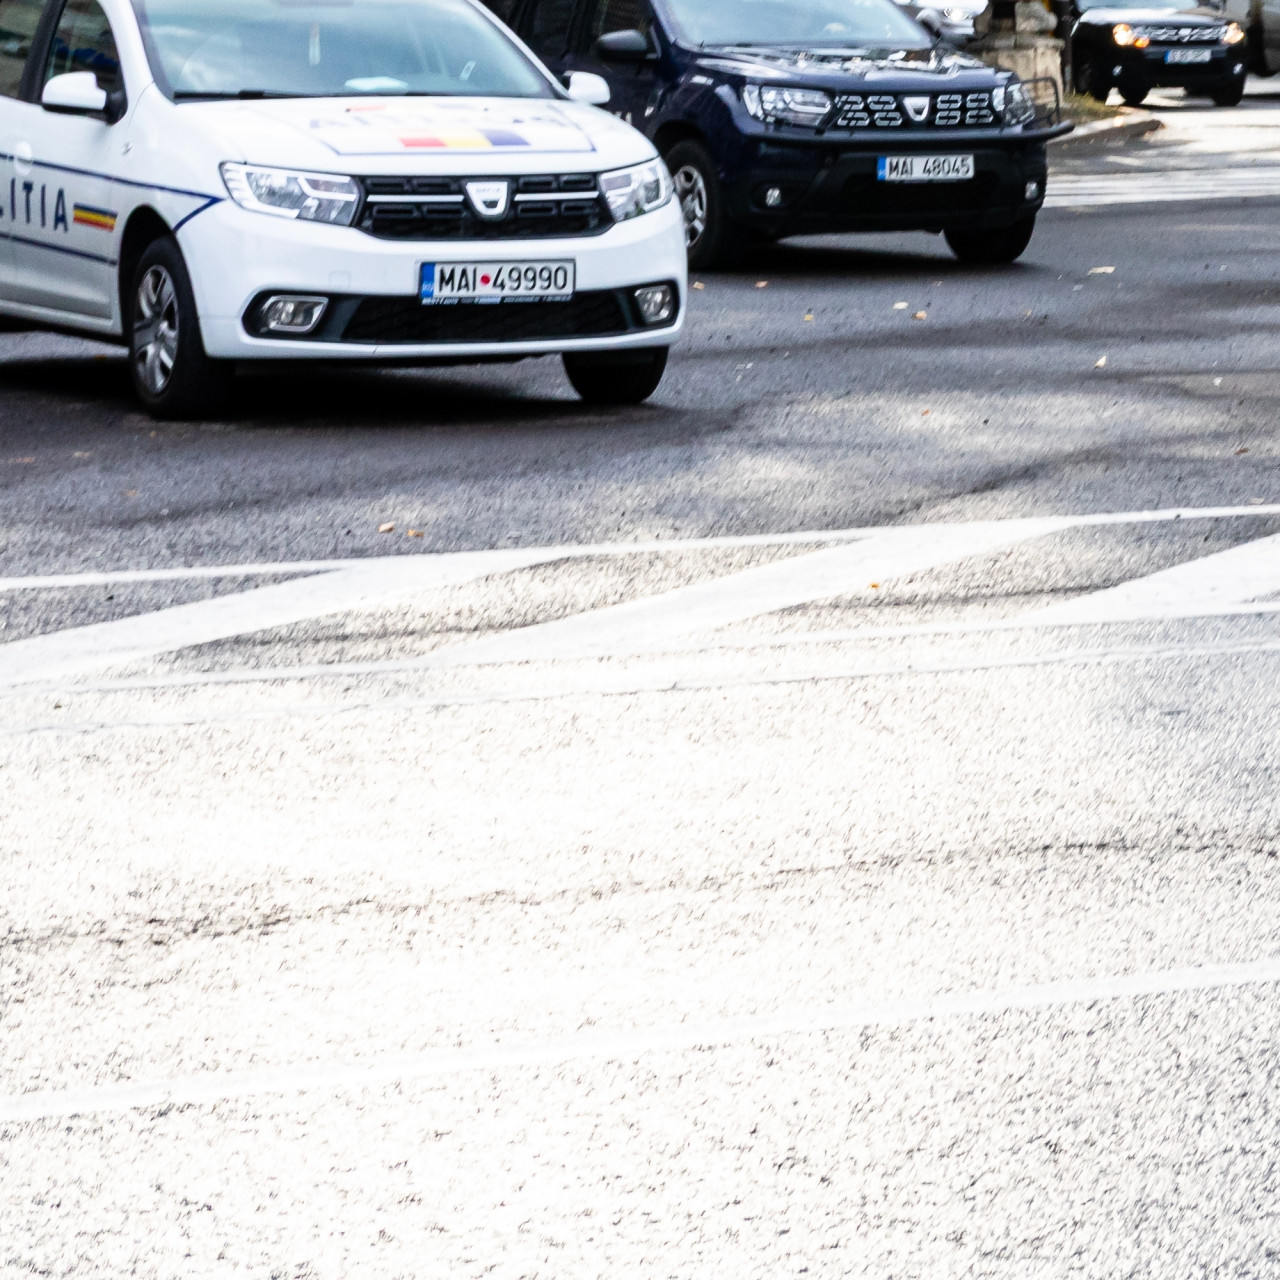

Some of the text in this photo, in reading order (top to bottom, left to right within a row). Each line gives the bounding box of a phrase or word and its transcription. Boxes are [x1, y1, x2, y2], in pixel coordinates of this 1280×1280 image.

[887, 157, 914, 178] MAI
[0, 176, 69, 234] ITIA
[438, 266, 477, 293] MAI
[492, 265, 568, 292] 49990
